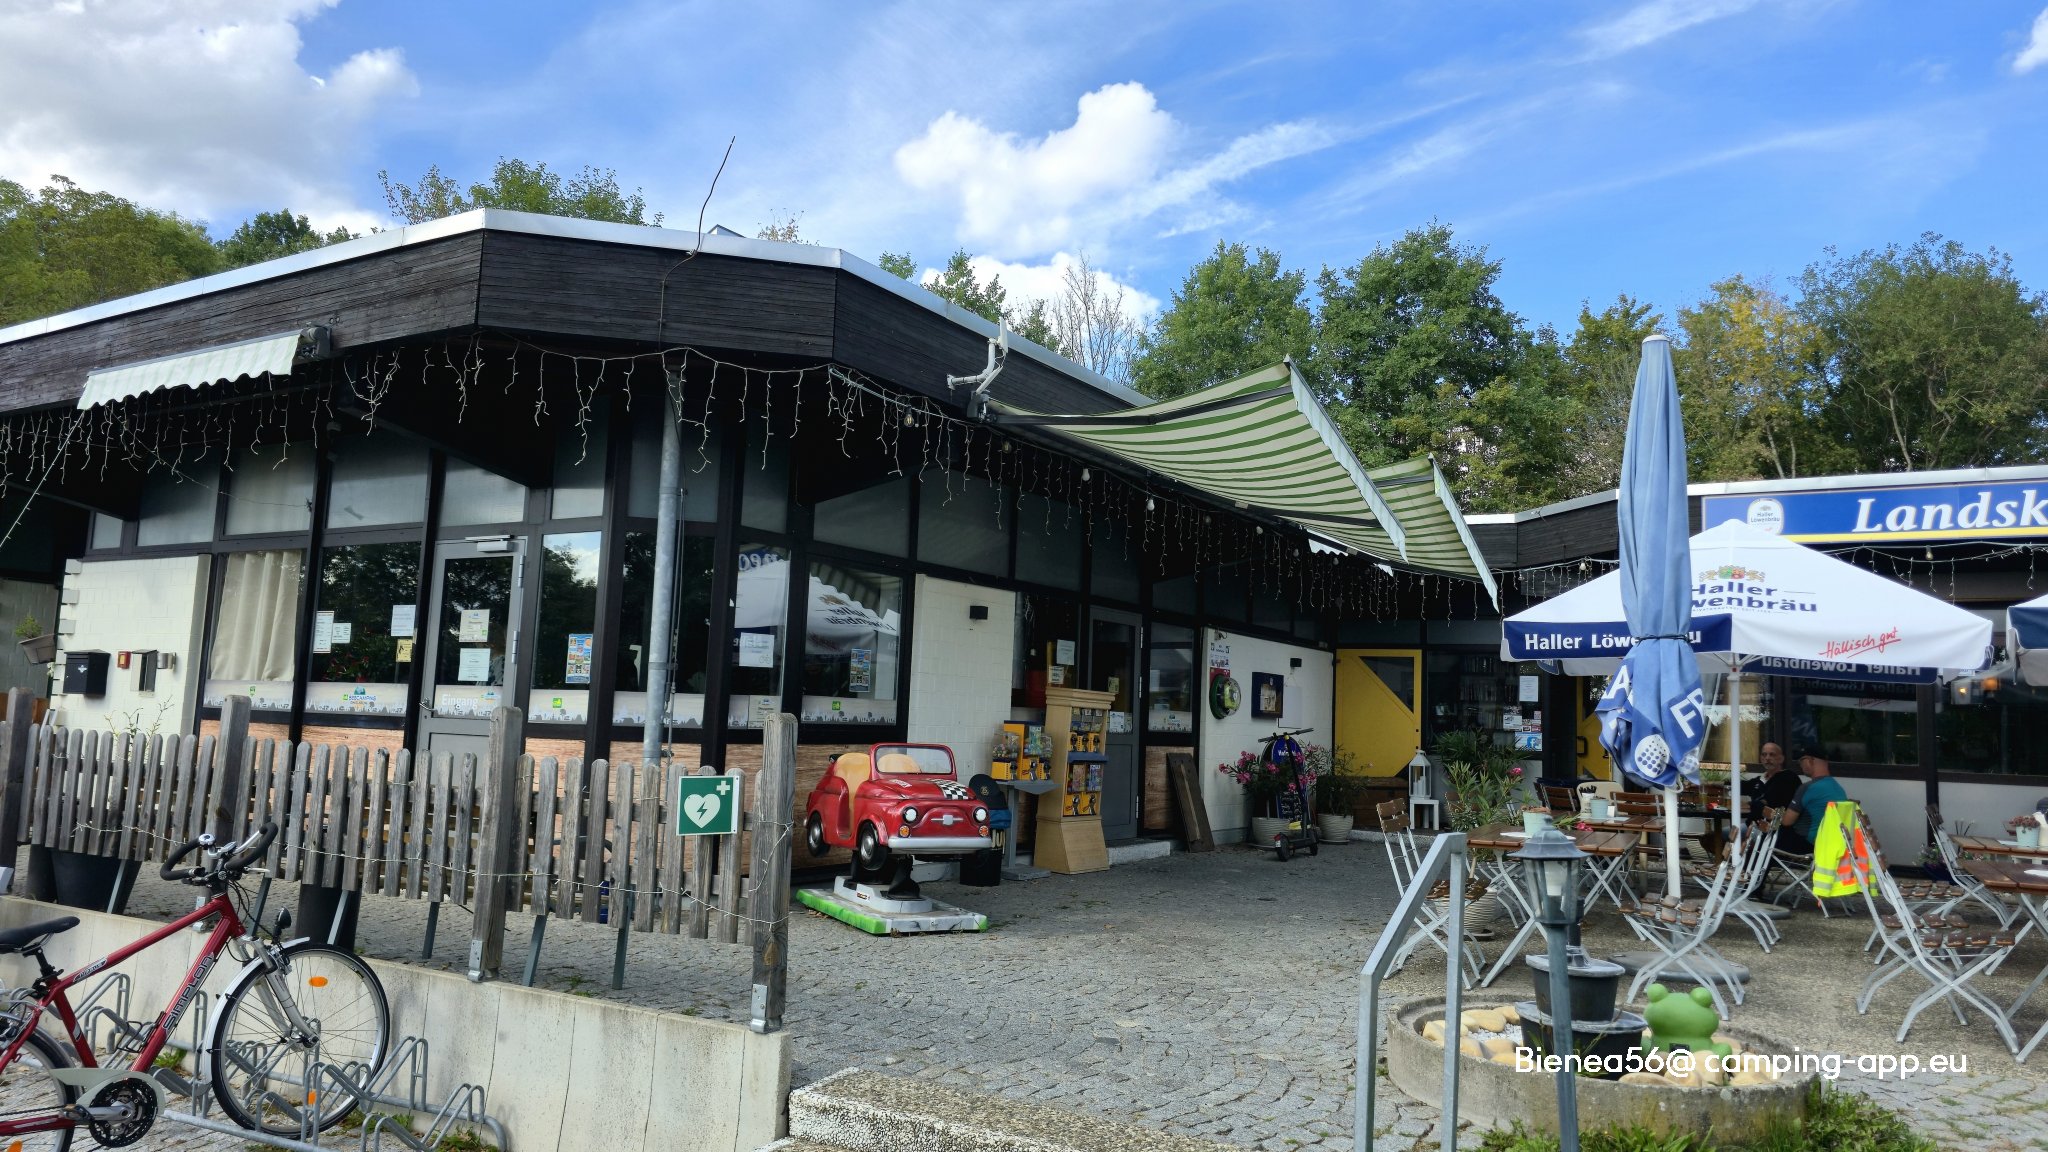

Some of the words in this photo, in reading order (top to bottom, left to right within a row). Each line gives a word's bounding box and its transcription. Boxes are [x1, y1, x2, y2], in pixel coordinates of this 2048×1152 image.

[1852, 489, 2048, 533] Landsk
[1691, 596, 1817, 612] wenbräu
[1525, 633, 1582, 650] Haller
[1819, 634, 1875, 658] Hällisch
[1879, 626, 1898, 653] gut
[442, 693, 479, 710] Eingang
[162, 955, 214, 1030] SIMPLON
